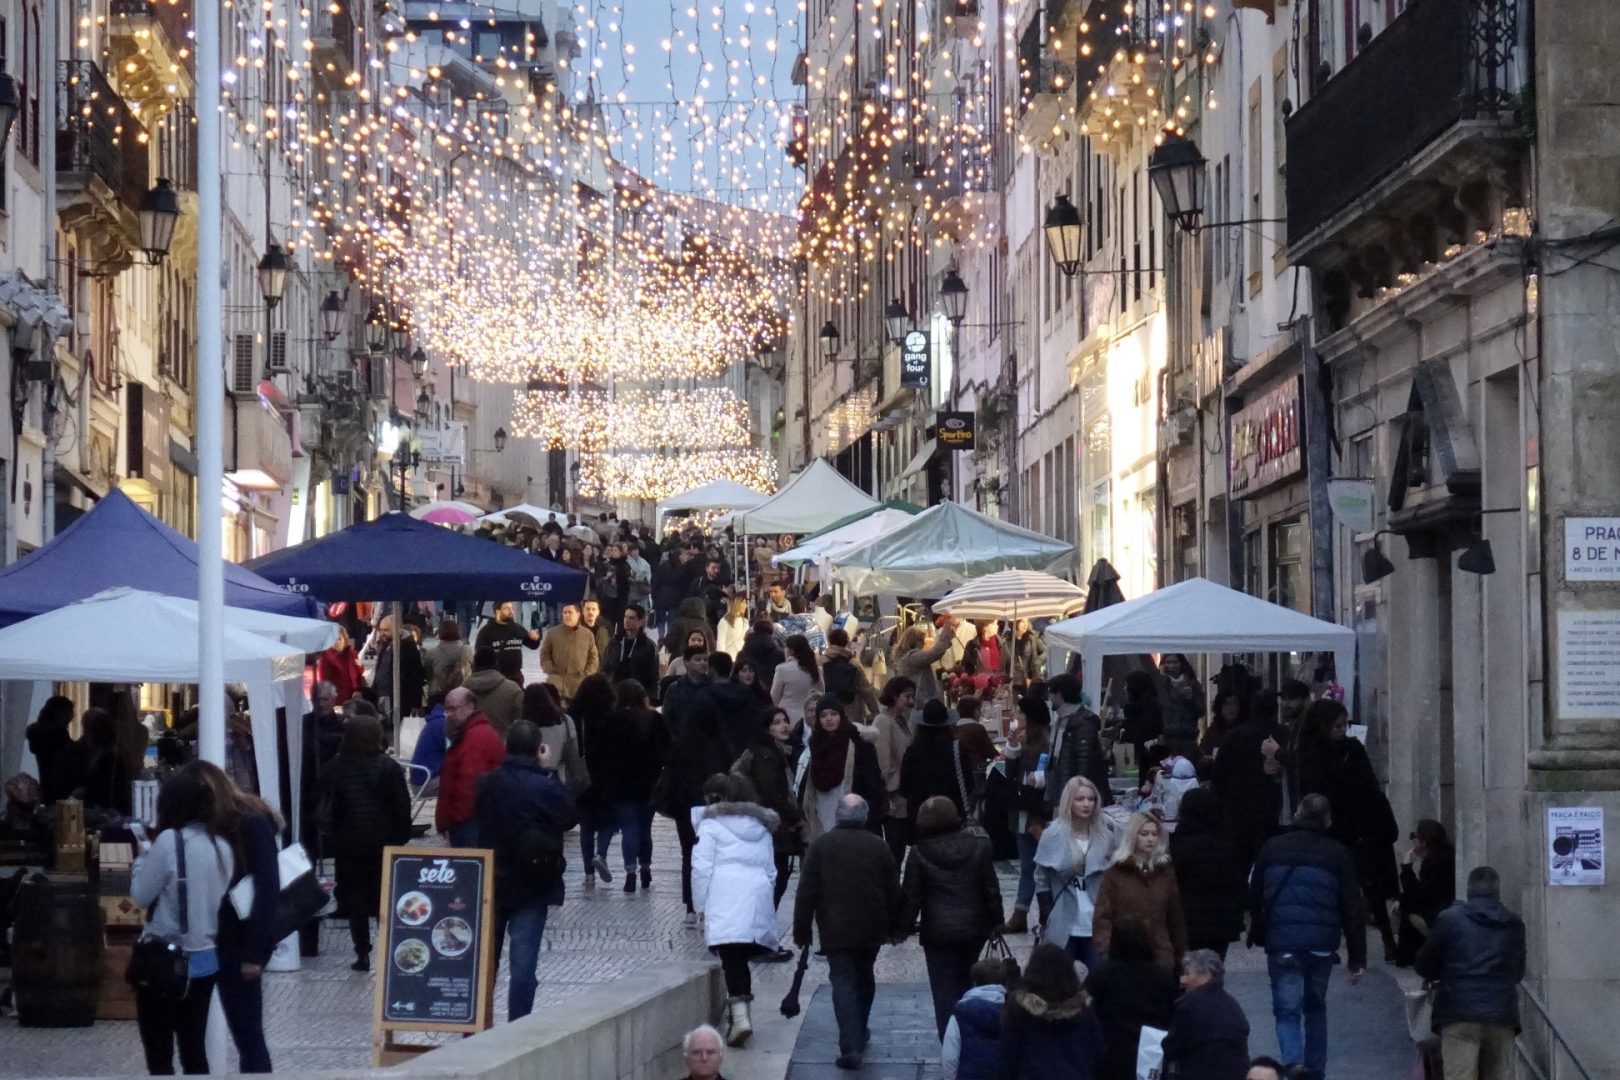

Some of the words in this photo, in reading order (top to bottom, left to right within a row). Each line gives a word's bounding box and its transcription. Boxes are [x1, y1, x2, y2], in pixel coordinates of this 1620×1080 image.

[904, 353, 927, 361] gang
[906, 364, 924, 372] four
[1572, 547, 1582, 561] 8
[1587, 546, 1608, 560] DE
